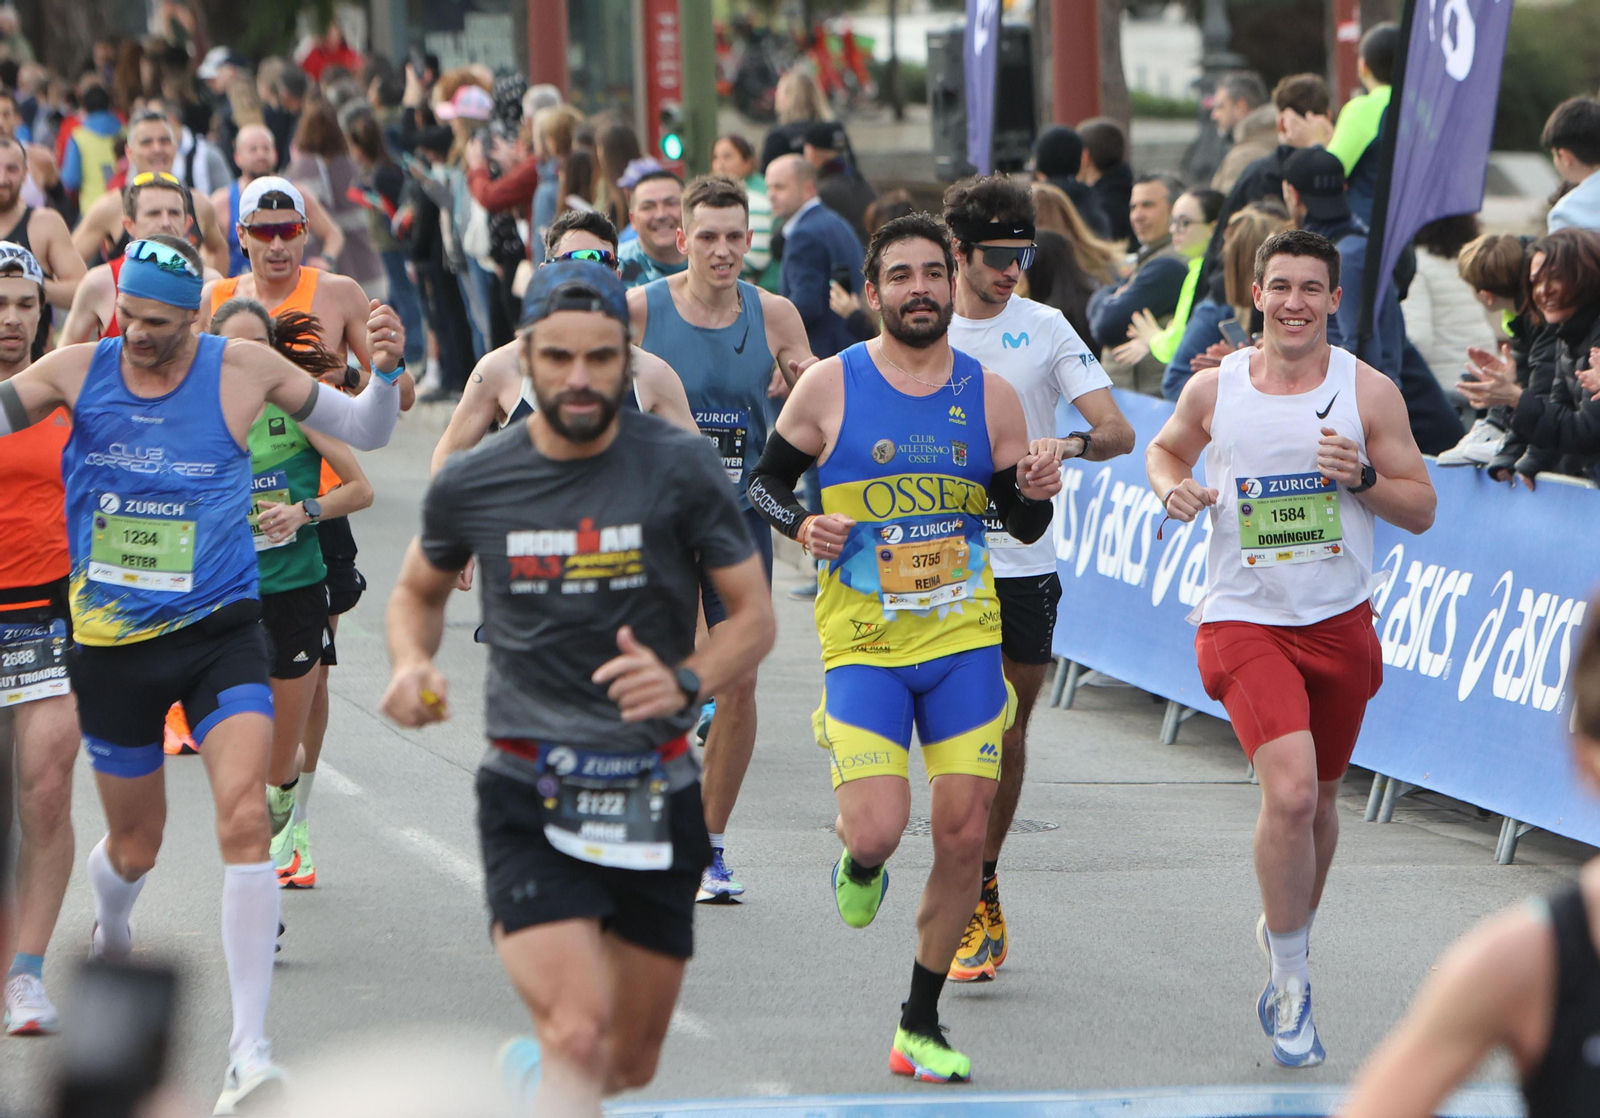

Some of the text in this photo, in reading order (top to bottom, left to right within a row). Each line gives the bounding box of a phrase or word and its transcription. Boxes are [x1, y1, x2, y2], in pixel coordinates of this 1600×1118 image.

[695, 412, 739, 424] ZURICH
[909, 434, 936, 444] CLUB
[109, 442, 164, 460] CLUB
[896, 444, 950, 455] ATLETISMO
[908, 455, 938, 464] OSSET
[1269, 477, 1325, 493] ZURICH
[863, 476, 977, 519] OSSET
[124, 500, 187, 516] ZURICH
[1271, 506, 1306, 523] 1584
[123, 529, 159, 547] 1234
[506, 517, 643, 557] IRONMAN
[909, 520, 956, 538] ZURICH
[1258, 529, 1325, 545] DOMÍNGUEZ
[121, 554, 158, 569] PETER
[912, 551, 941, 569] 3755
[915, 574, 941, 590] REINA
[1381, 560, 1588, 712] asics asics
[2, 648, 36, 667] 2688
[18, 665, 68, 686] TROADEC
[842, 751, 891, 769] OSSET
[577, 790, 626, 815] 2122
